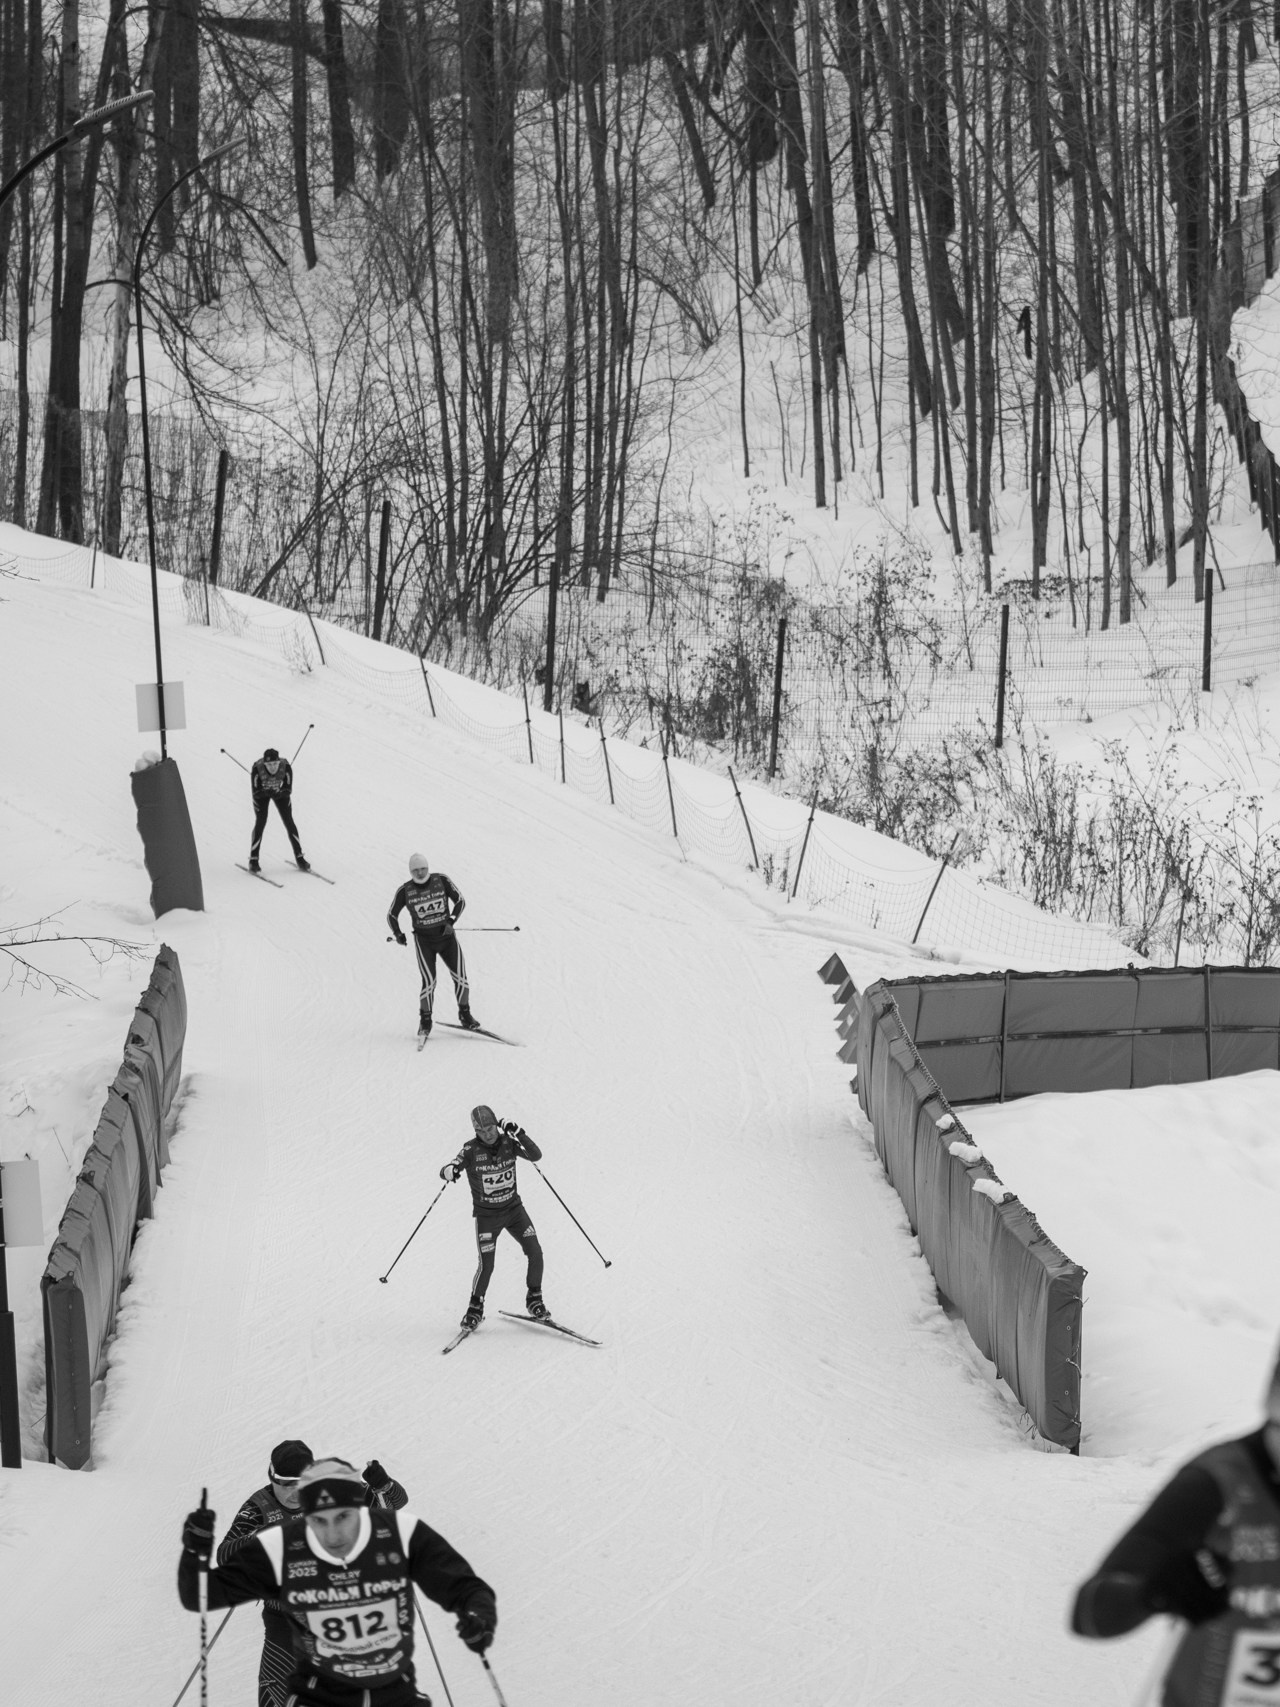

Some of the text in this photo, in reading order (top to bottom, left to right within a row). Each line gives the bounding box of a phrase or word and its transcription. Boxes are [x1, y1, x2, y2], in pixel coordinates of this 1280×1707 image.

[418, 900, 442, 913] 447
[484, 1170, 513, 1185] 420
[288, 1567, 318, 1579] 2025
[328, 1570, 361, 1581] CHERY
[321, 1610, 389, 1643] 812
